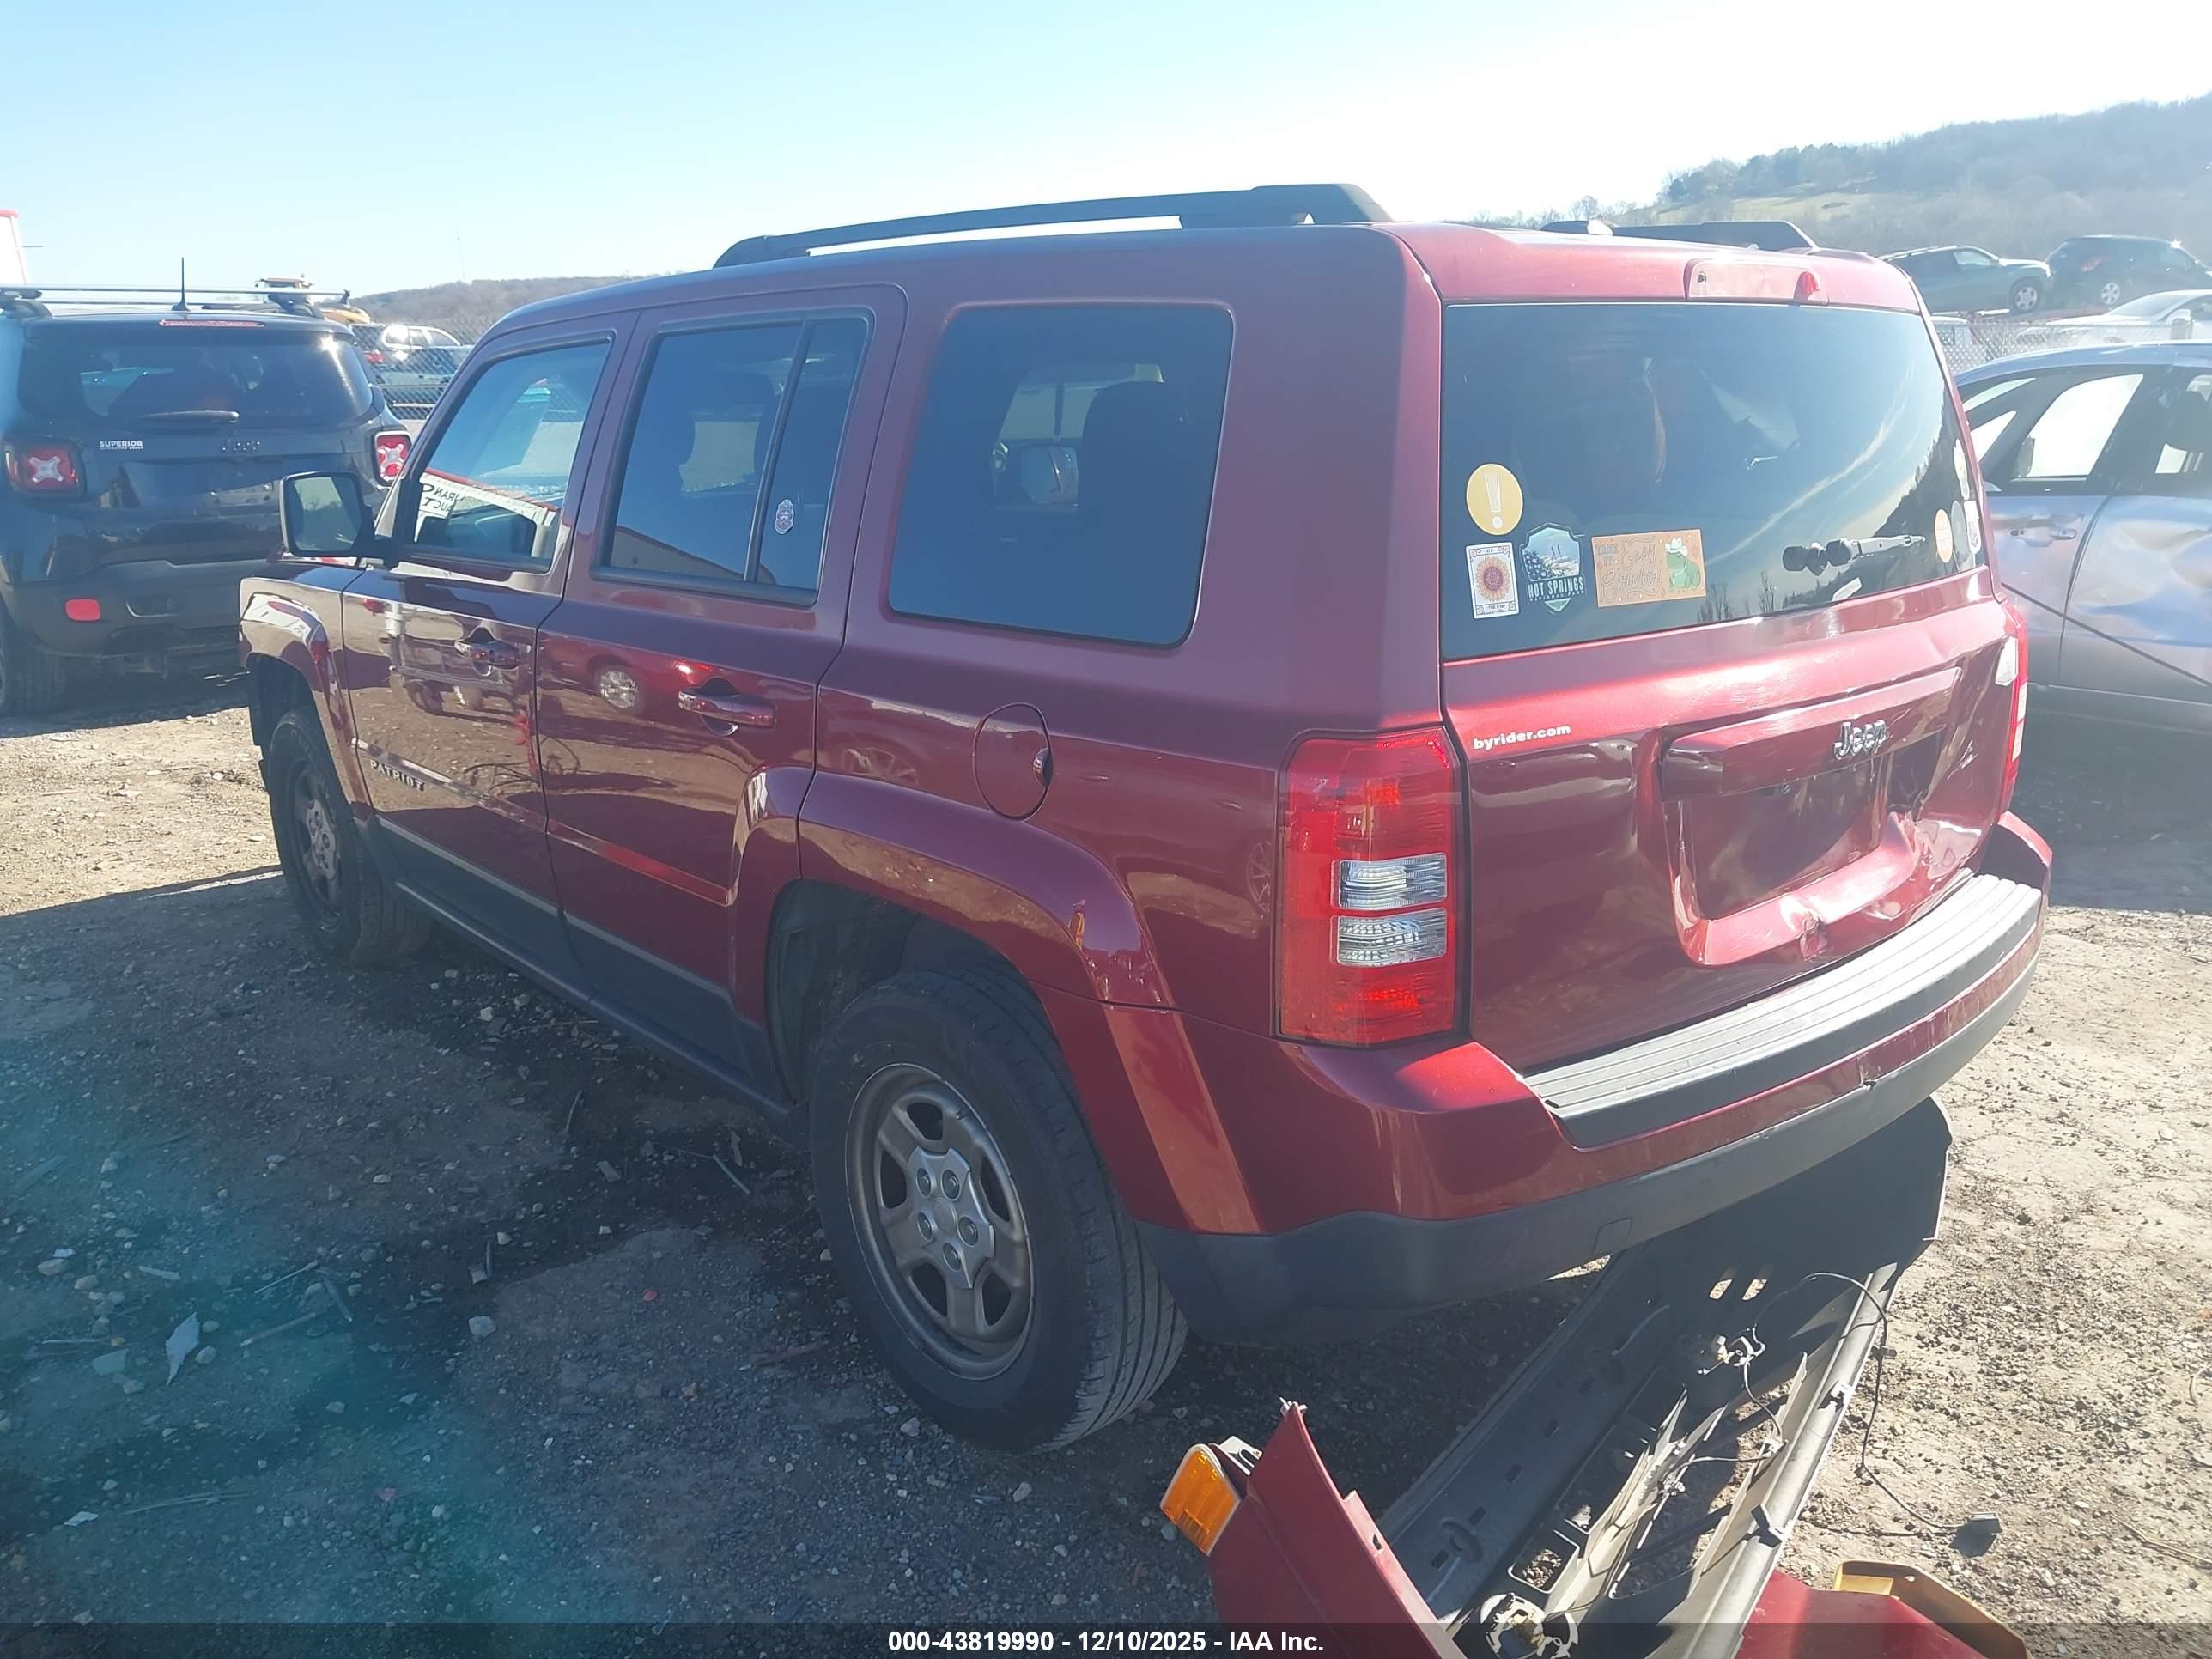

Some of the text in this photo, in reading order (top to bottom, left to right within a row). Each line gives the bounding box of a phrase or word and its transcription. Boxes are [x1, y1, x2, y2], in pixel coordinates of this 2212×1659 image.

[1528, 576, 1584, 599] HOT SPRINGS
[1473, 725, 1571, 750] byrider.com
[1833, 720, 1887, 760] Jeep
[370, 758, 426, 791] PATRIOT
